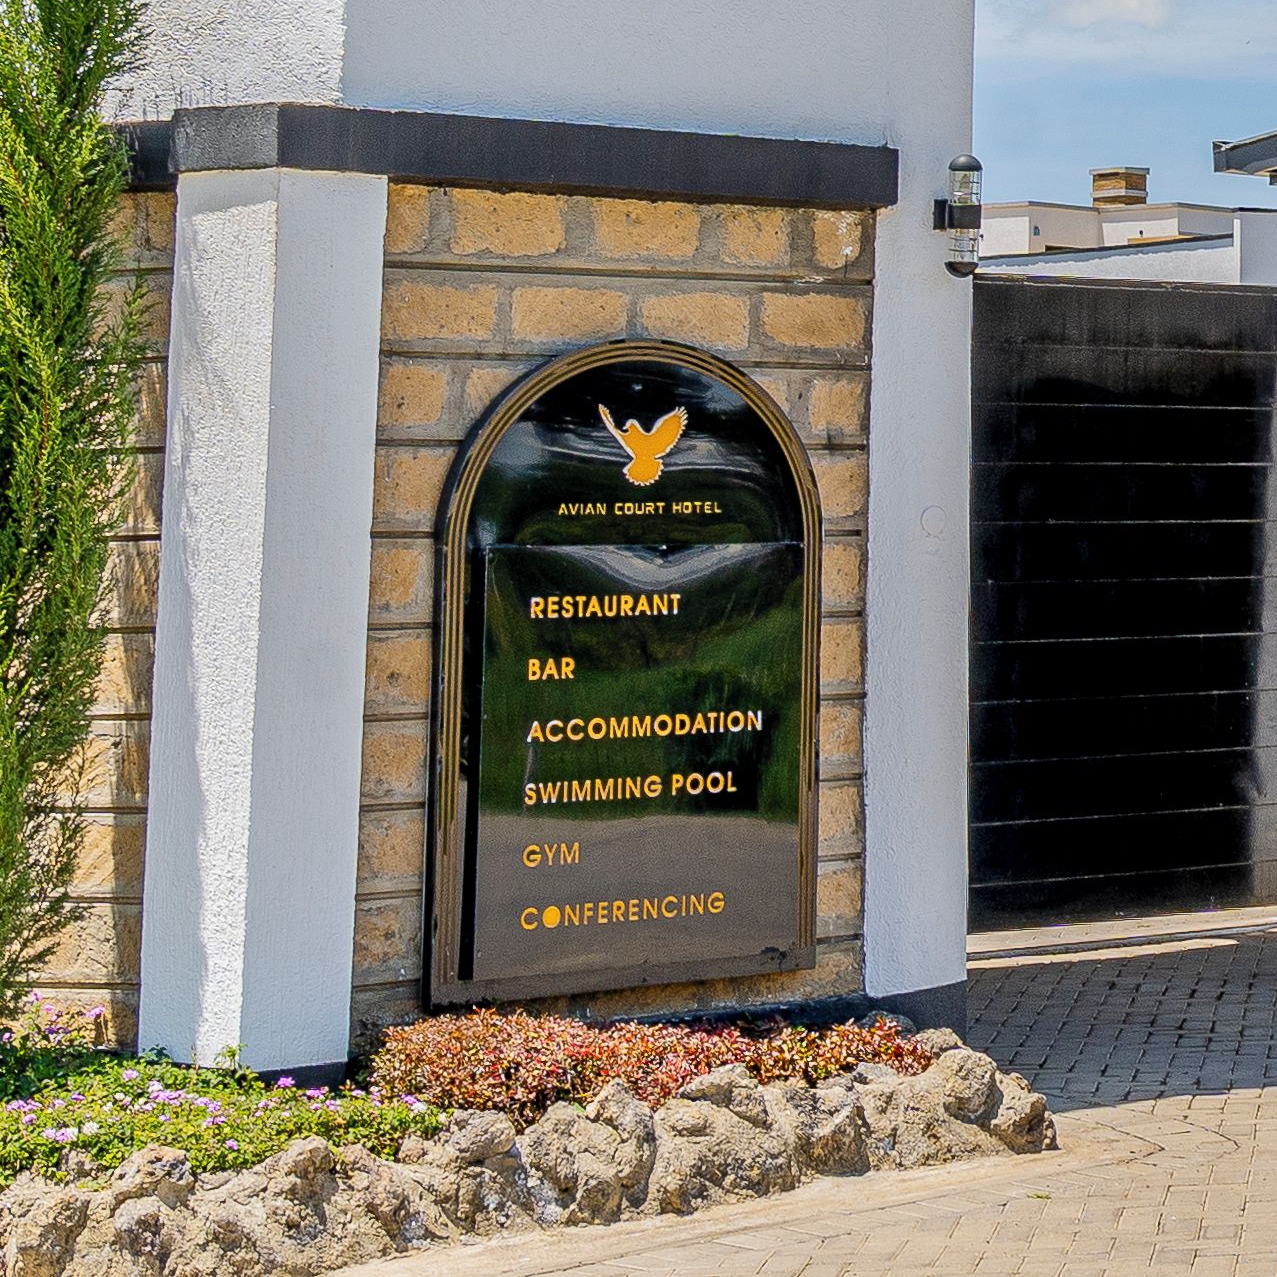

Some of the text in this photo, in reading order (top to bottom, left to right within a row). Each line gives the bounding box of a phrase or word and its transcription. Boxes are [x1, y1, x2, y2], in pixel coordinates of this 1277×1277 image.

[558, 501, 722, 516] AVIAN COURT HOTEL
[530, 593, 681, 619] RESTAURANT
[528, 657, 575, 681] BAR
[526, 710, 763, 743] ACCOMMODATION
[524, 771, 737, 805] SWIMMING POOL
[522, 841, 580, 868] GYM
[520, 891, 725, 930] CONFERENCING
